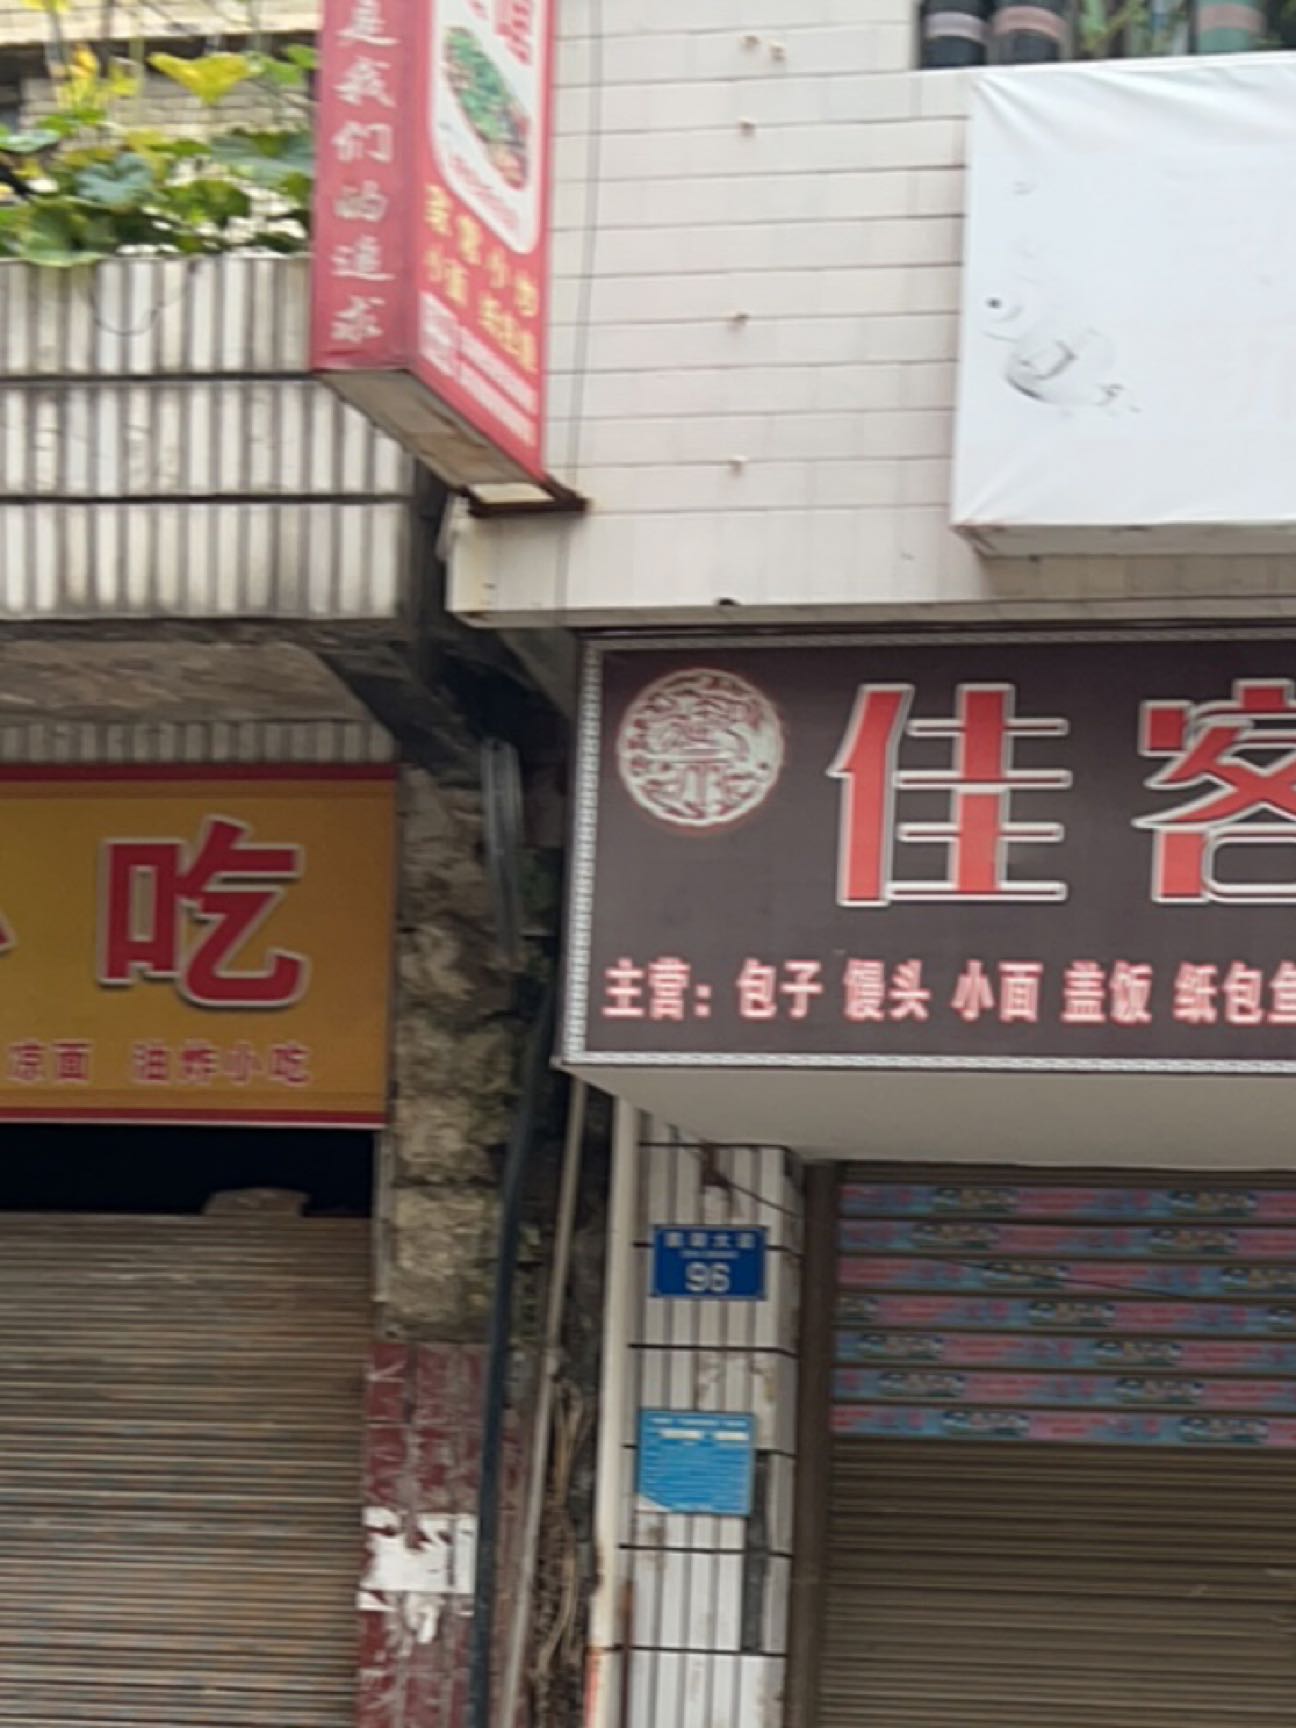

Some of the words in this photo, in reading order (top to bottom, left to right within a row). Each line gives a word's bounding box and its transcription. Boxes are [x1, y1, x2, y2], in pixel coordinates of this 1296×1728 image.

[0, 813, 308, 1006] 吃
[735, 957, 824, 1020] 包子
[843, 959, 931, 1021] 馒头
[951, 961, 1045, 1024] 小面
[1061, 962, 1153, 1025] 盖饭
[684, 1261, 731, 1293] 96
